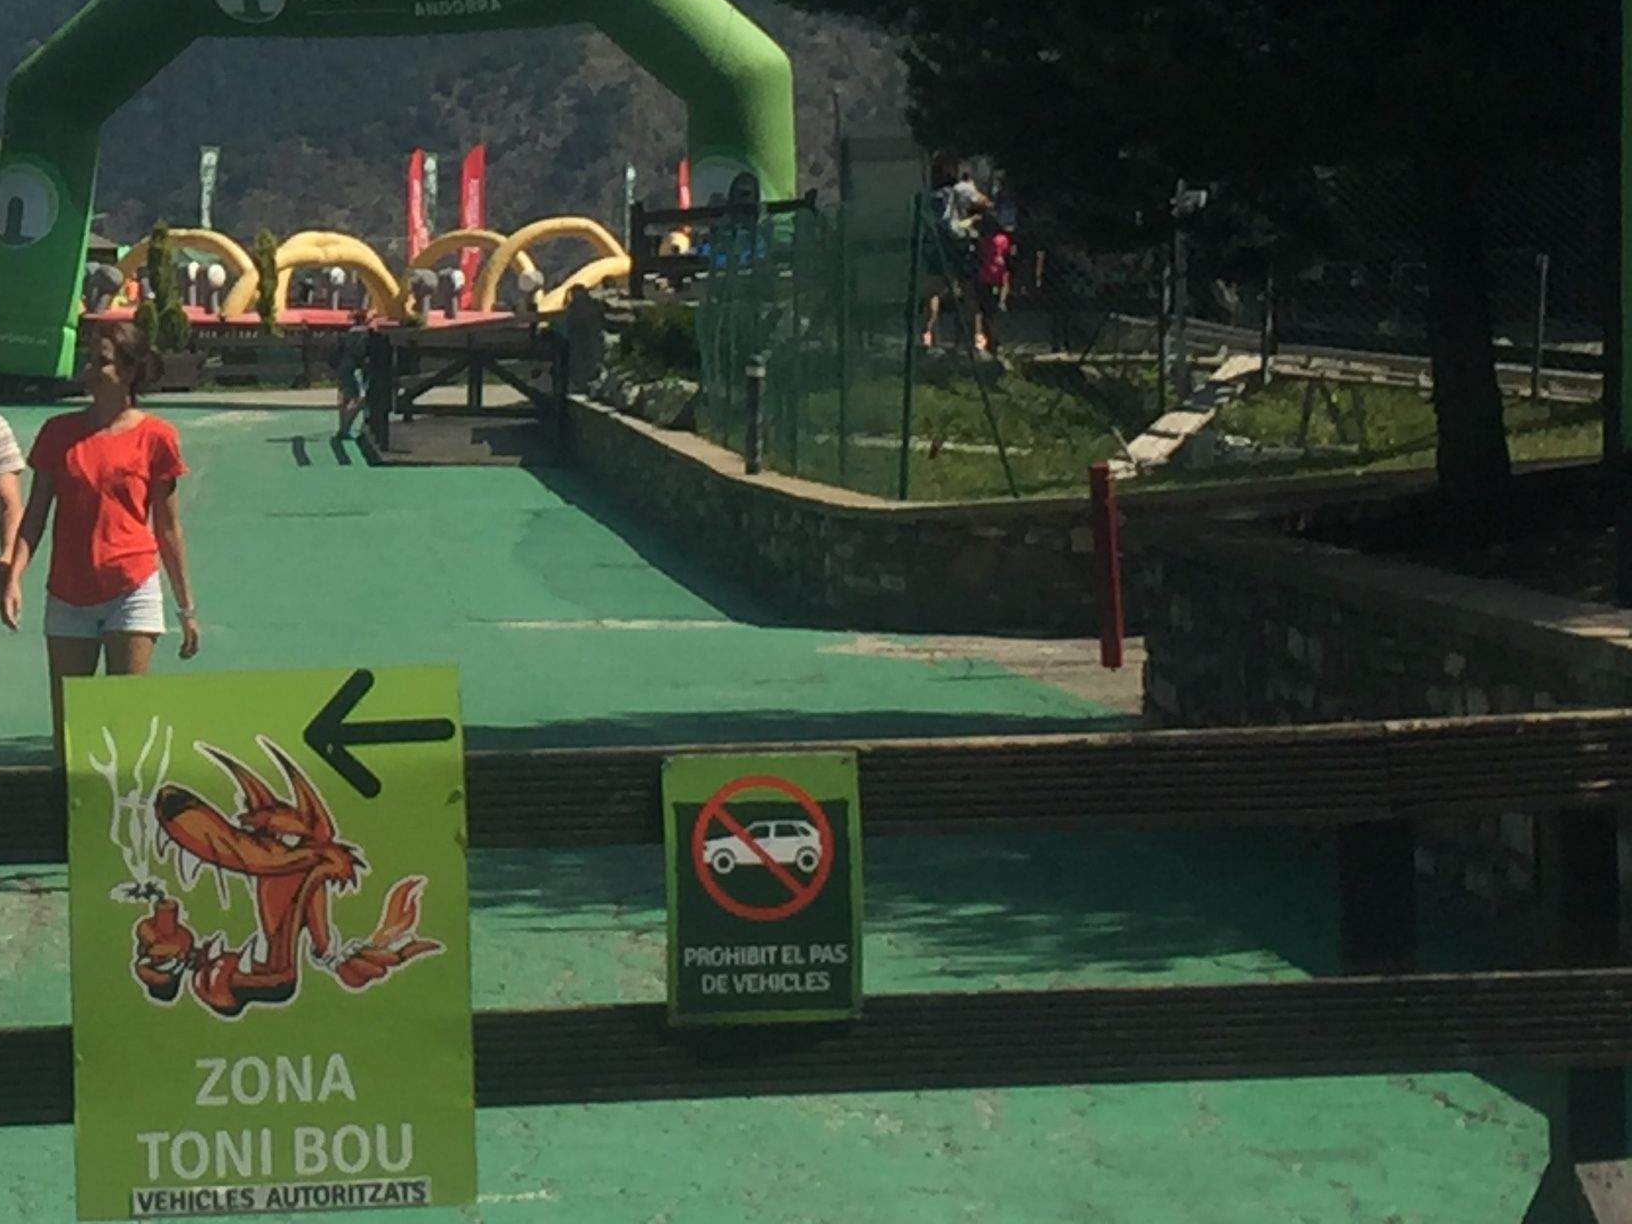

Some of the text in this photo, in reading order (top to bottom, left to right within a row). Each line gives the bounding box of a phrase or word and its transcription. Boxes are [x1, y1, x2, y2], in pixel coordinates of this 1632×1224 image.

[684, 944, 849, 967] PROHIBIT EL PAS
[701, 971, 831, 994] DE VEHICLES
[195, 1053, 357, 1106] ZONA
[136, 1123, 414, 1181] TONI BOU
[137, 1180, 427, 1213] VEHICLES AUTORITZATS
